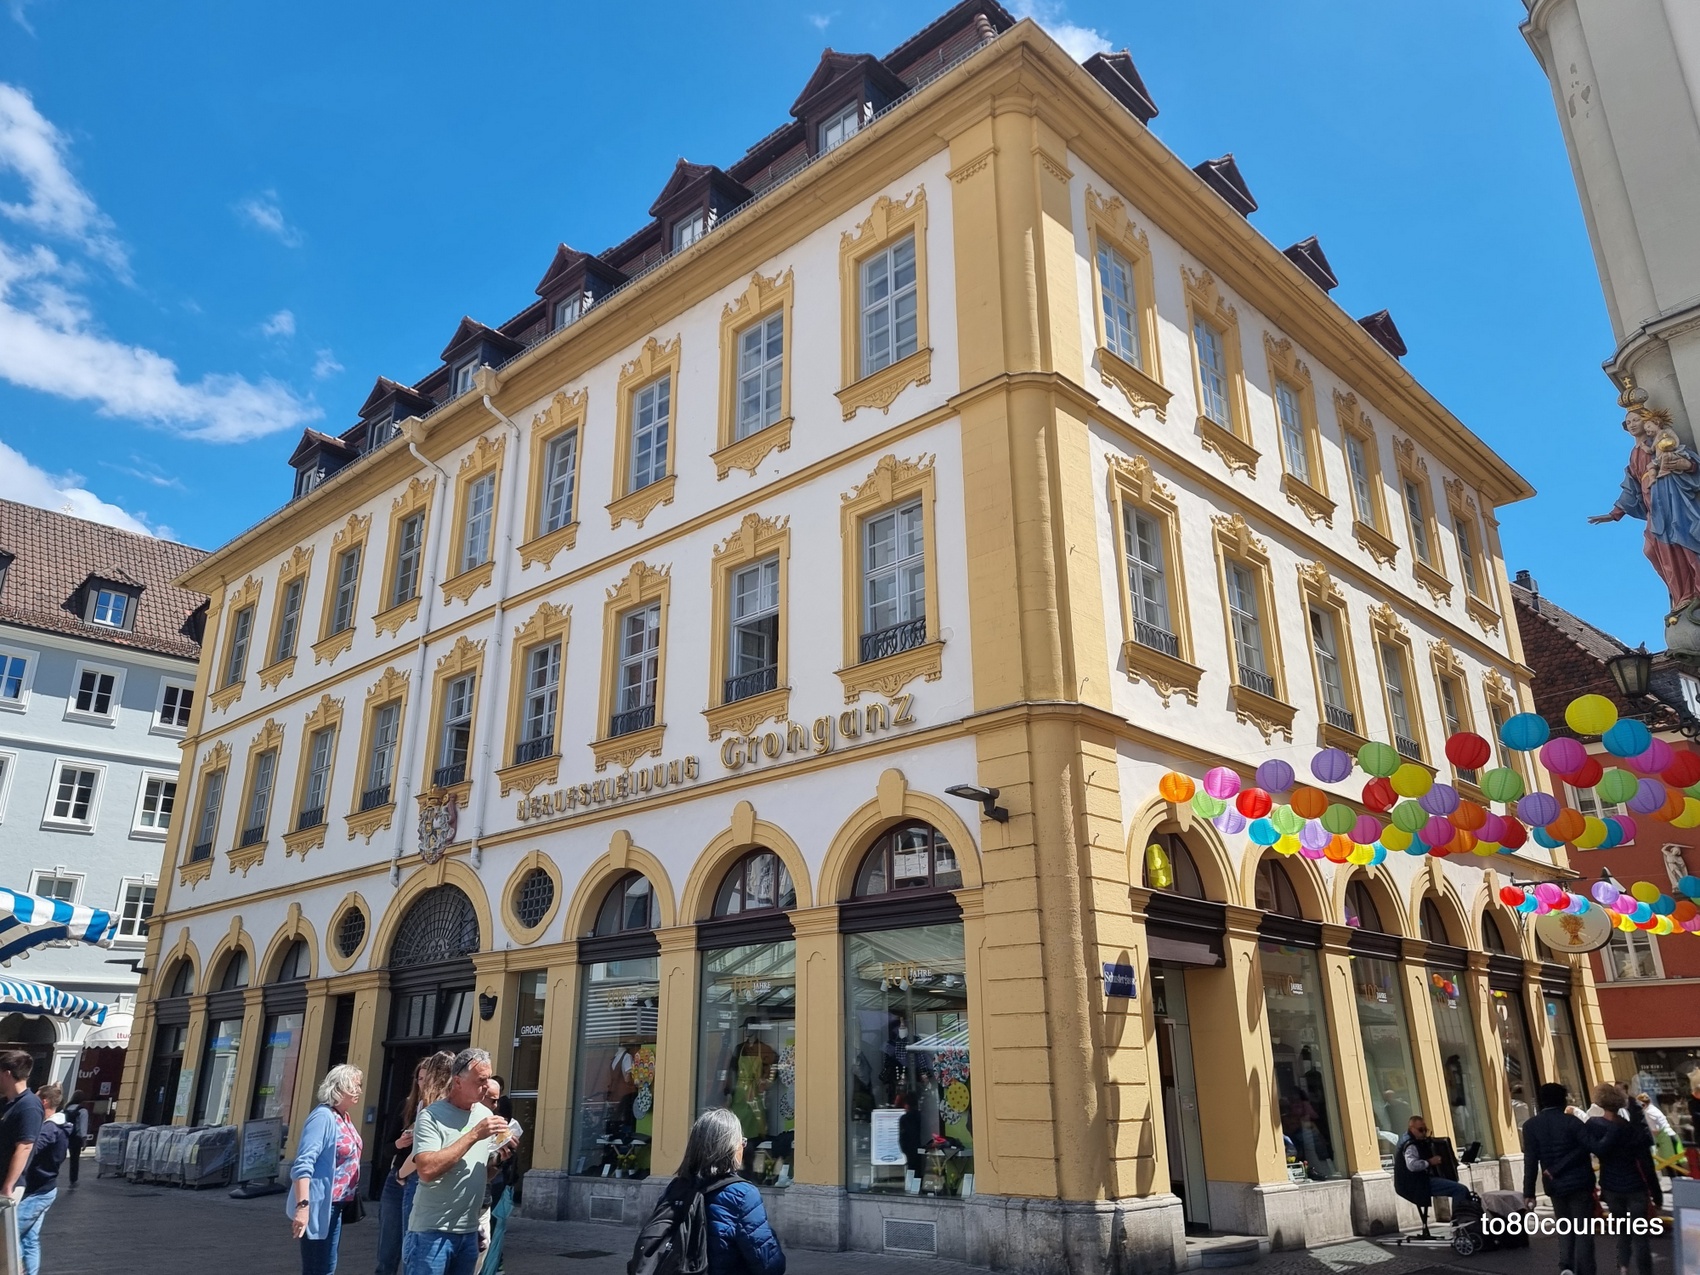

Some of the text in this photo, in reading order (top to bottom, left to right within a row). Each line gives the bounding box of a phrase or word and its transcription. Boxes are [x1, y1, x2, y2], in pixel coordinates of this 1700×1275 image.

[516, 693, 916, 822] BERUFSKLEIDUNG Grohganz
[909, 968, 932, 979] JAHRE
[753, 982, 771, 990] JAHRE
[521, 1025, 543, 1035] GROHG
